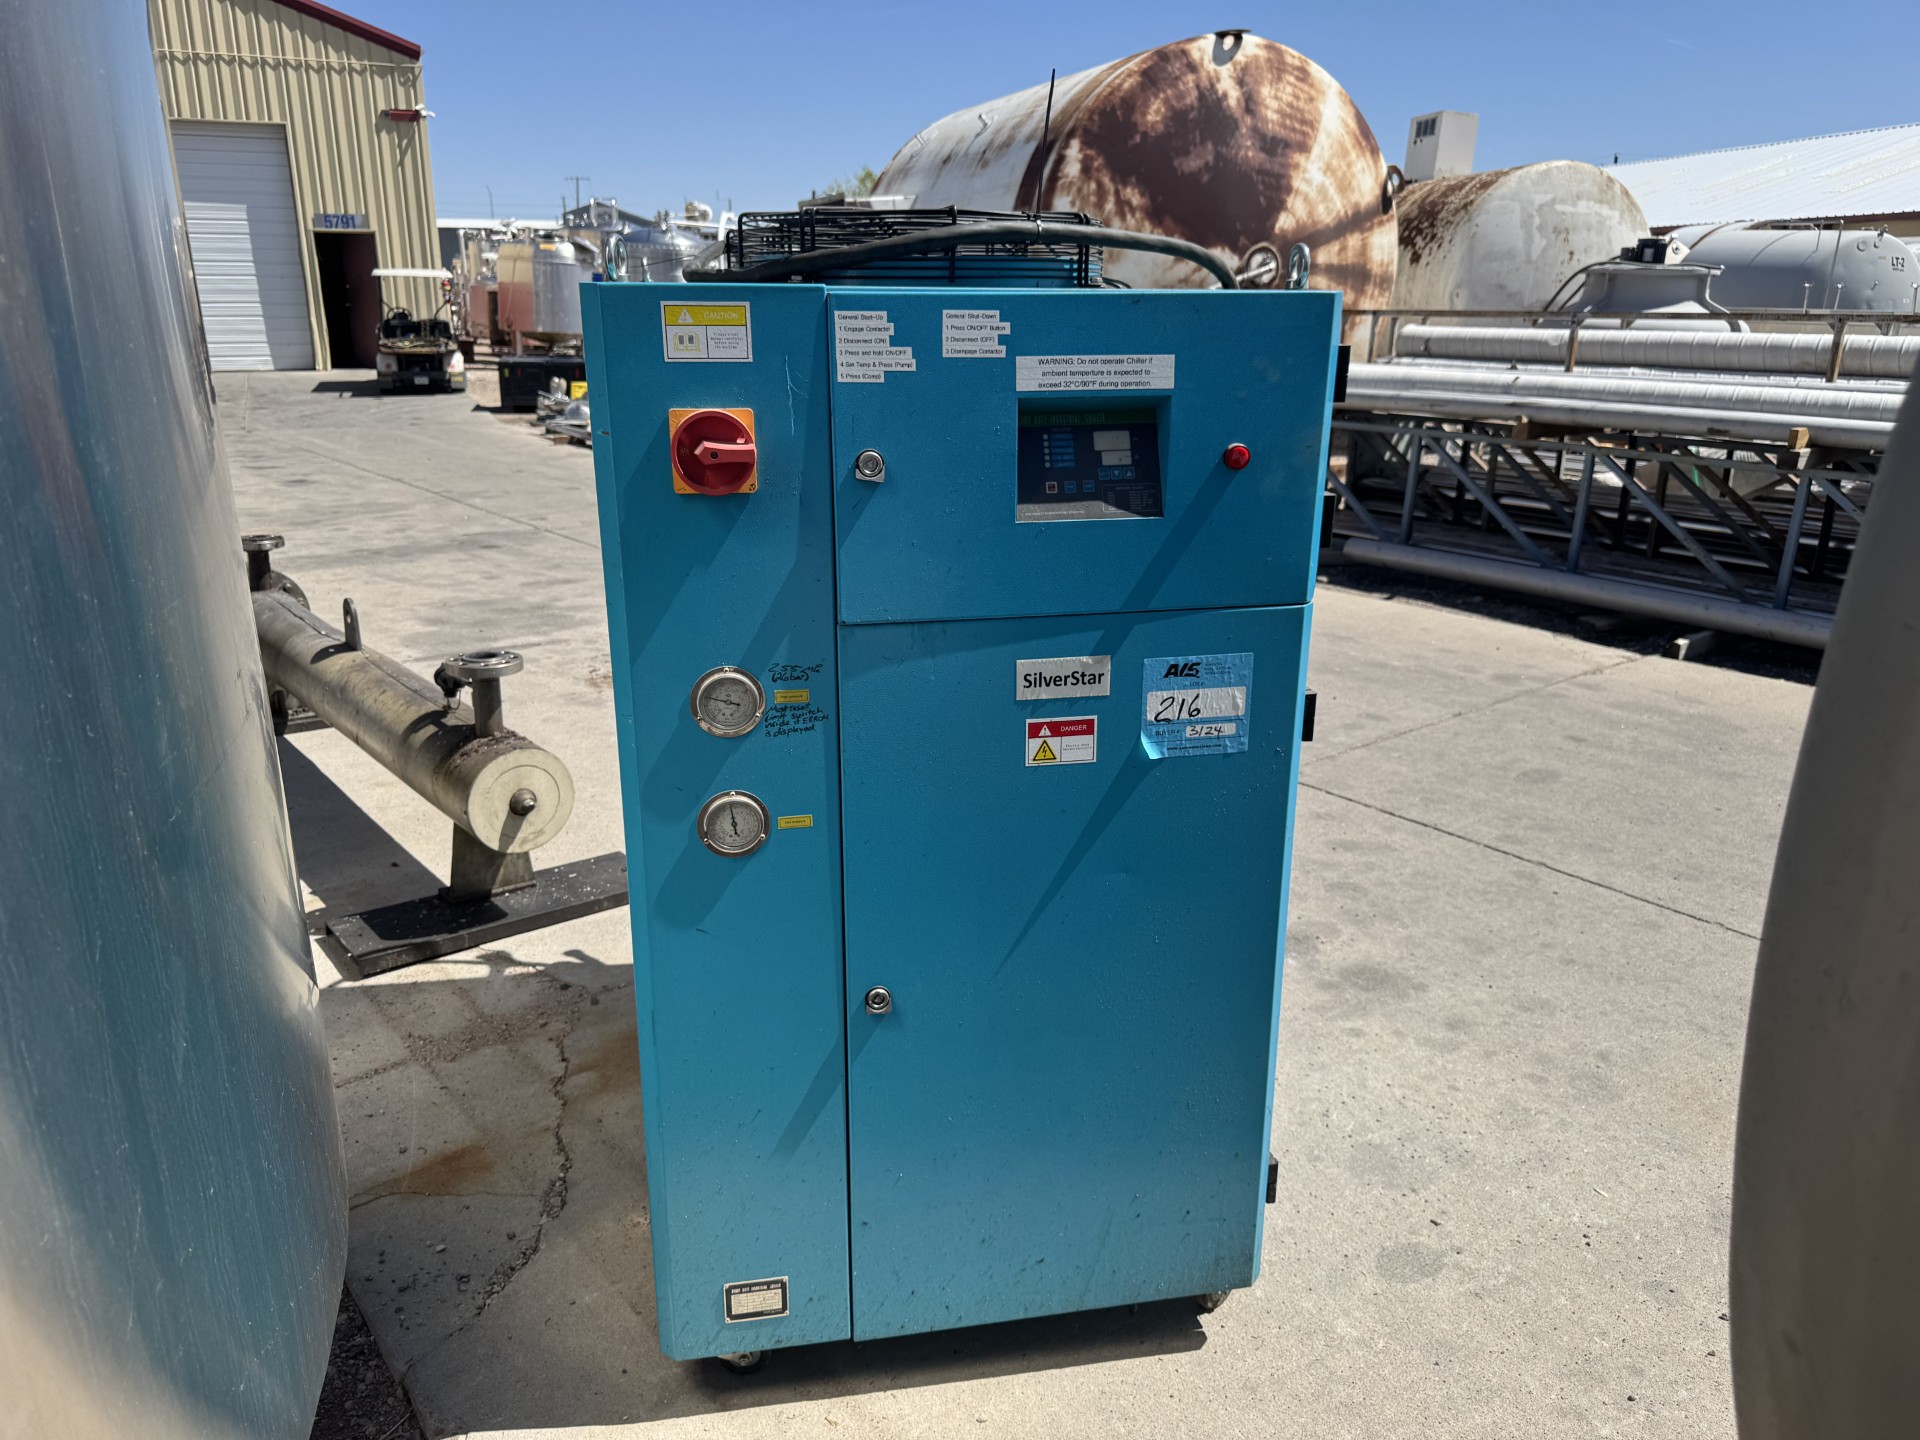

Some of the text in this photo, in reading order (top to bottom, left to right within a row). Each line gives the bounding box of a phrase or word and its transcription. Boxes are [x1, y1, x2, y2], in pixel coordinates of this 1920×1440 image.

[324, 214, 356, 229] 5791
[1892, 256, 1904, 267] LT-2
[1120, 380, 1152, 388] operation.
[1023, 671, 1105, 688] SilverStar
[1154, 693, 1201, 724] 216
